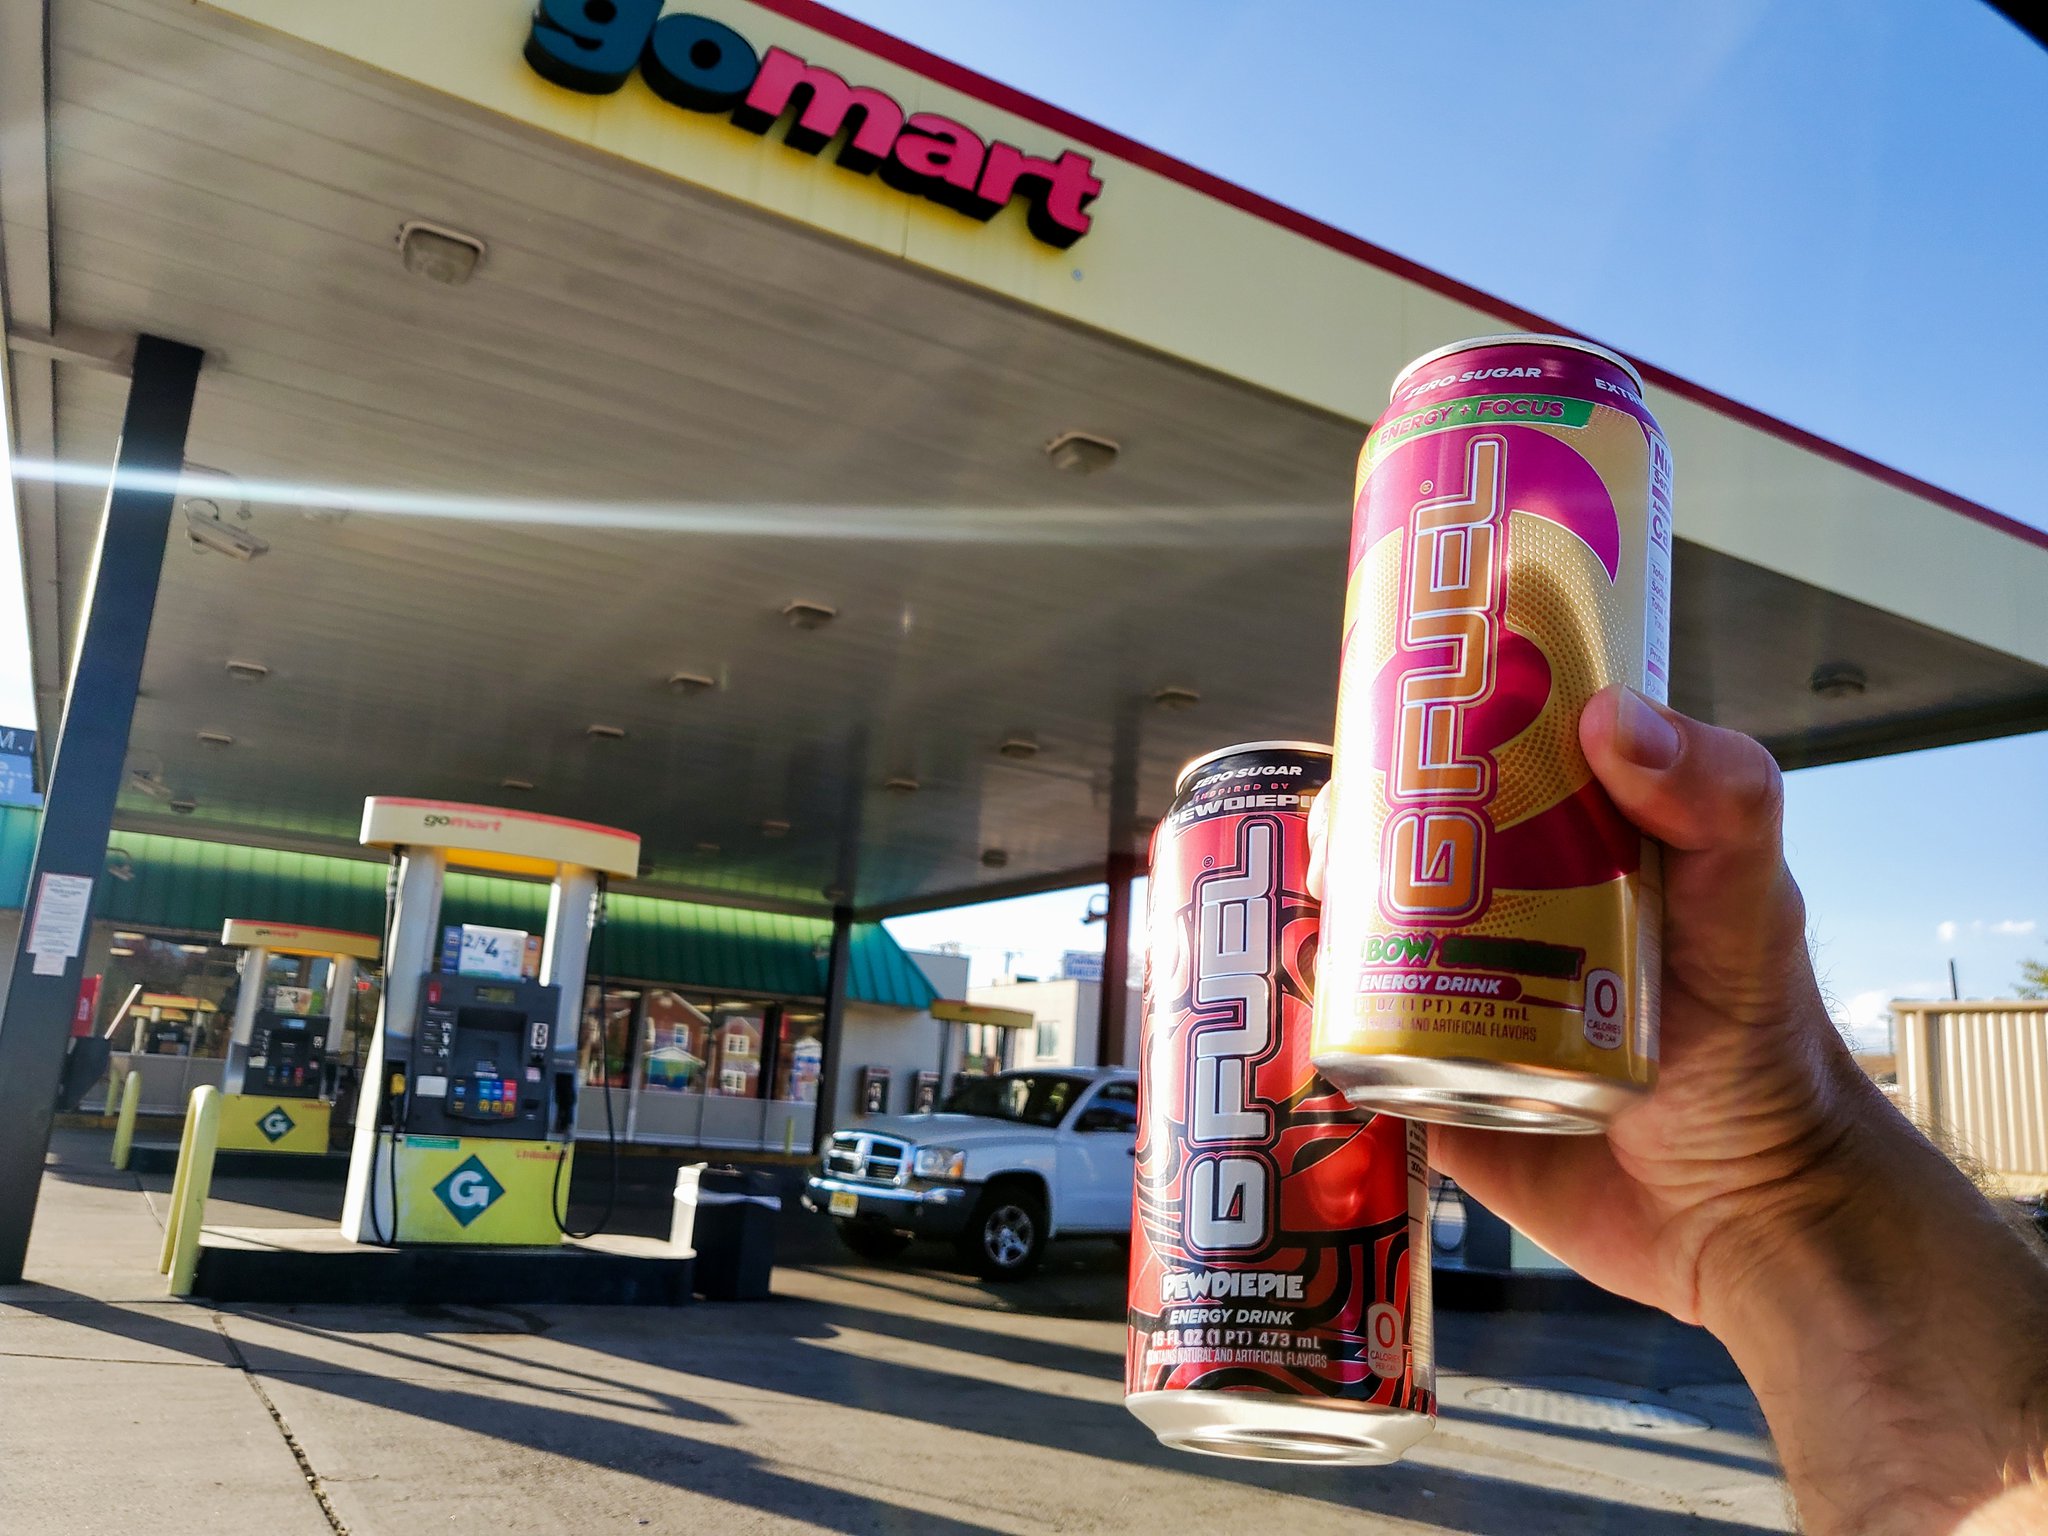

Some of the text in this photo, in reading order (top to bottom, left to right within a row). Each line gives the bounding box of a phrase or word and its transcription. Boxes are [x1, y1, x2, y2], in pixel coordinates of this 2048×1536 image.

[524, 0, 1104, 250] gomart
[1402, 367, 1543, 401] ZERO SUGAR
[1379, 404, 1456, 446] ENERGY
[1476, 398, 1565, 418] FOCUS
[1191, 765, 1303, 792] ZERO SUGAR
[1360, 974, 1502, 994] ENERGY DRINK
[1459, 1001, 1495, 1017] 473
[1503, 1003, 1530, 1022] mL
[1594, 977, 1618, 1019] 0
[1432, 1019, 1488, 1037] ARTIFICIAL
[1490, 1022, 1537, 1042] FLAVORS
[1586, 1019, 1621, 1036] CALORIES
[448, 1170, 490, 1208] G
[1162, 1270, 1304, 1301] PEWDIEPIE
[1169, 1308, 1296, 1326] ENERGY DRINK
[1375, 1311, 1396, 1349] 0
[1183, 1328, 1203, 1347] OZ
[1258, 1331, 1291, 1348] 473
[1297, 1335, 1321, 1350] mL
[1177, 1346, 1213, 1364] NATURAL
[1214, 1348, 1234, 1363] AND
[1234, 1348, 1285, 1365] ARTIFICIAL
[1286, 1351, 1328, 1369] FLAVORS
